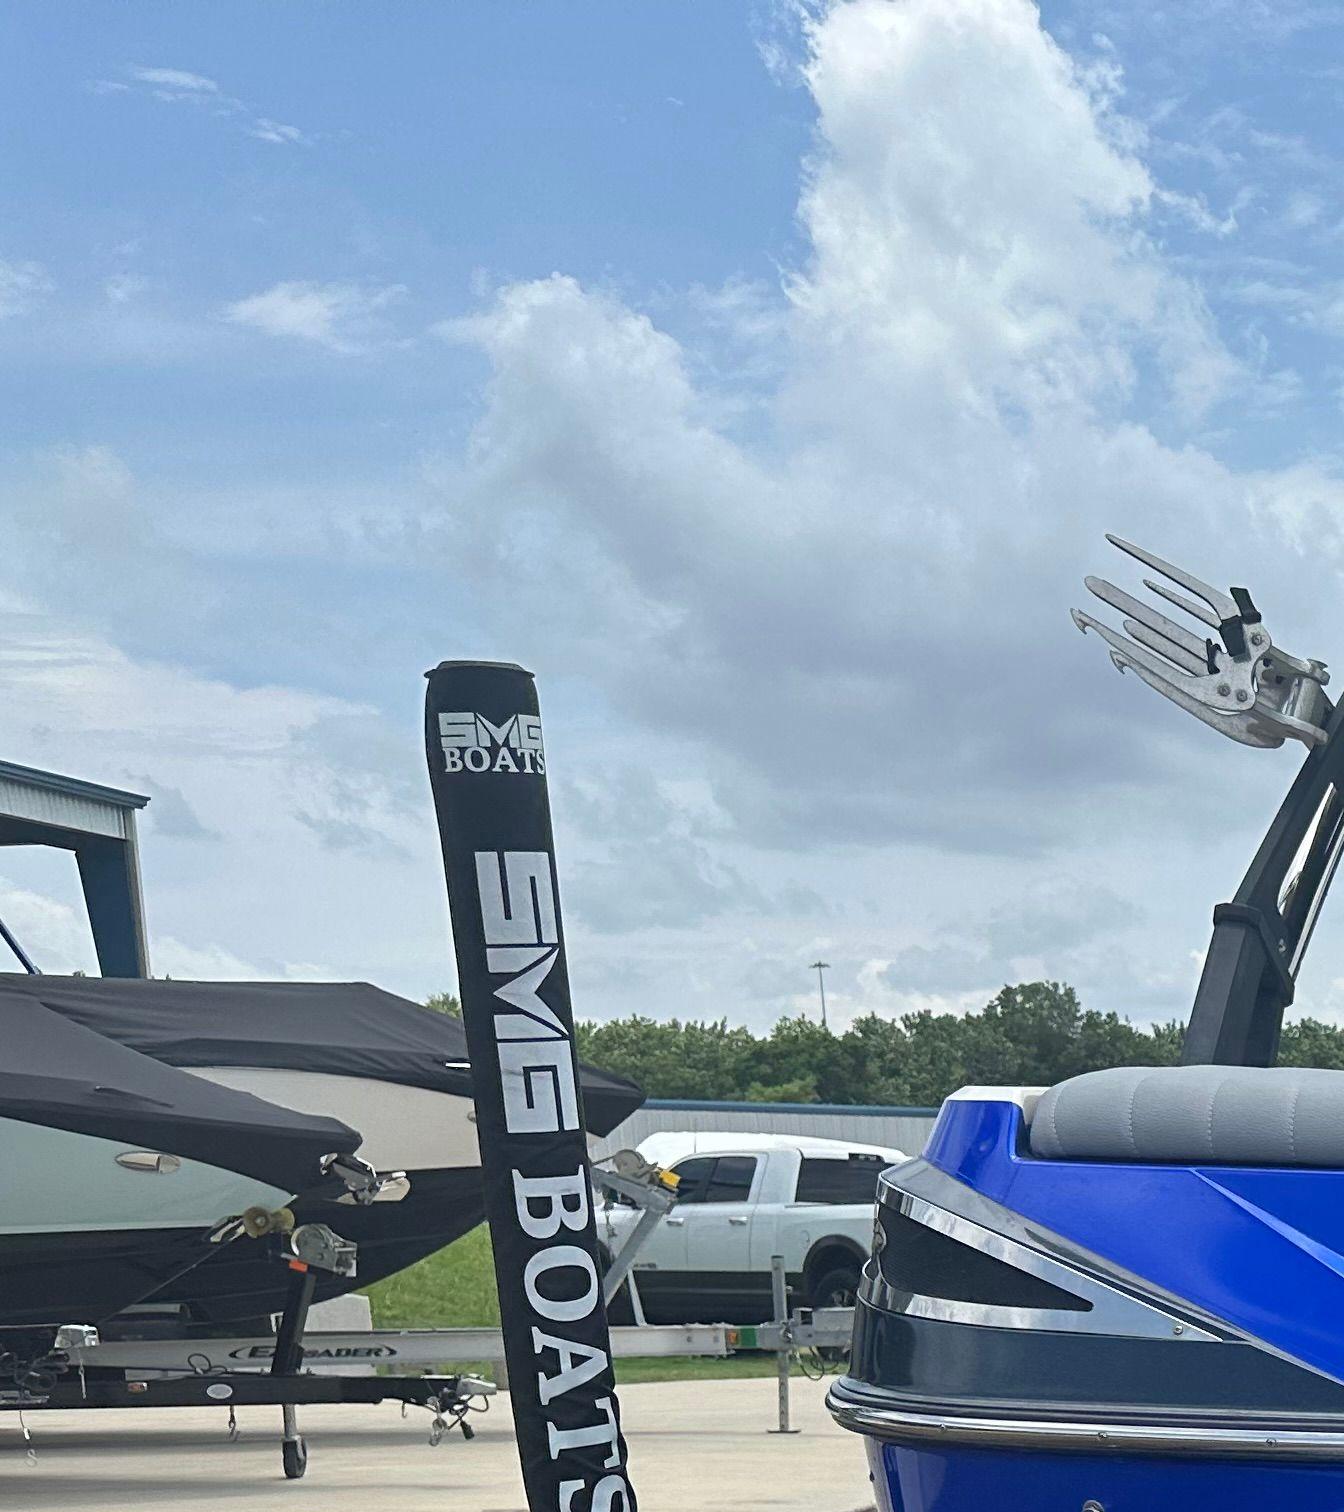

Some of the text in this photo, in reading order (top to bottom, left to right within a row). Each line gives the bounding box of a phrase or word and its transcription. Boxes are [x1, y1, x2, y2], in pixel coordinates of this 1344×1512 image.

[438, 712, 542, 749] SMG
[442, 747, 546, 776] BOATS
[474, 851, 580, 1135] SMG
